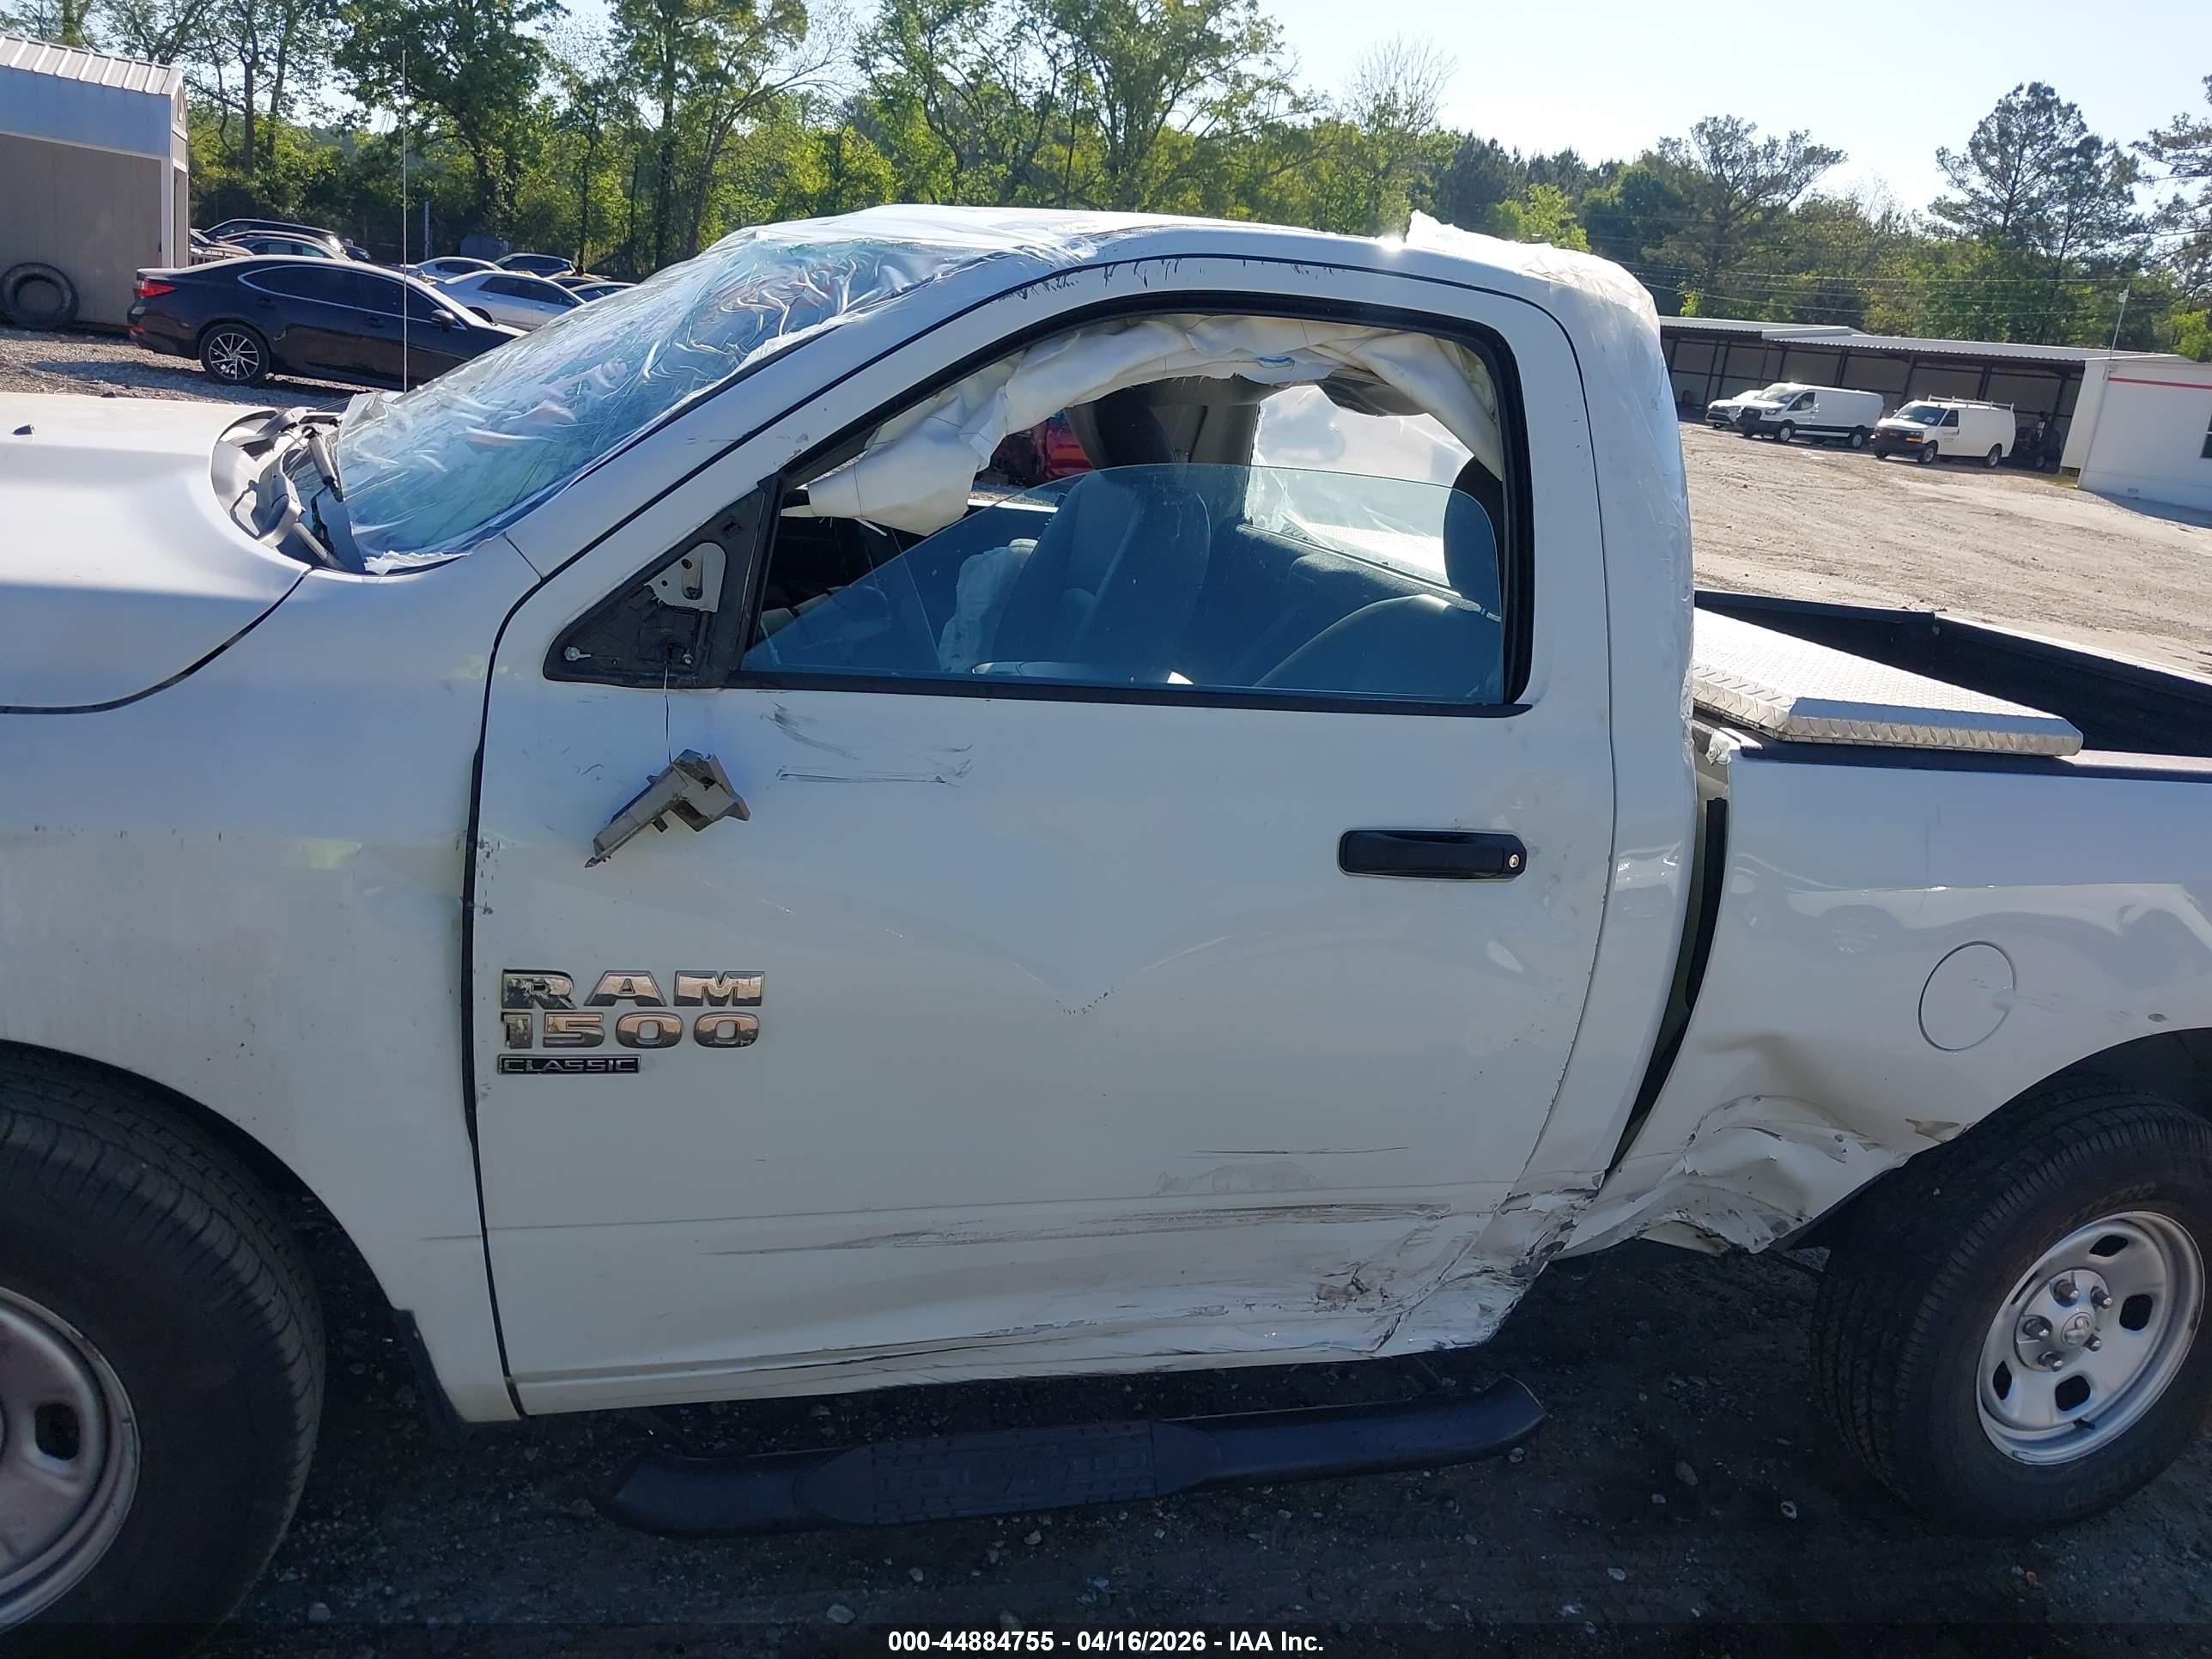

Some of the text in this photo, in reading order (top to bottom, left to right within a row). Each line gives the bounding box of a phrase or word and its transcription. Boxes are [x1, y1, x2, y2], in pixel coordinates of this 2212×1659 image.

[502, 969, 764, 1010] RAM
[501, 1012, 760, 1049] 1500
[503, 1059, 636, 1073] CLASSIC
